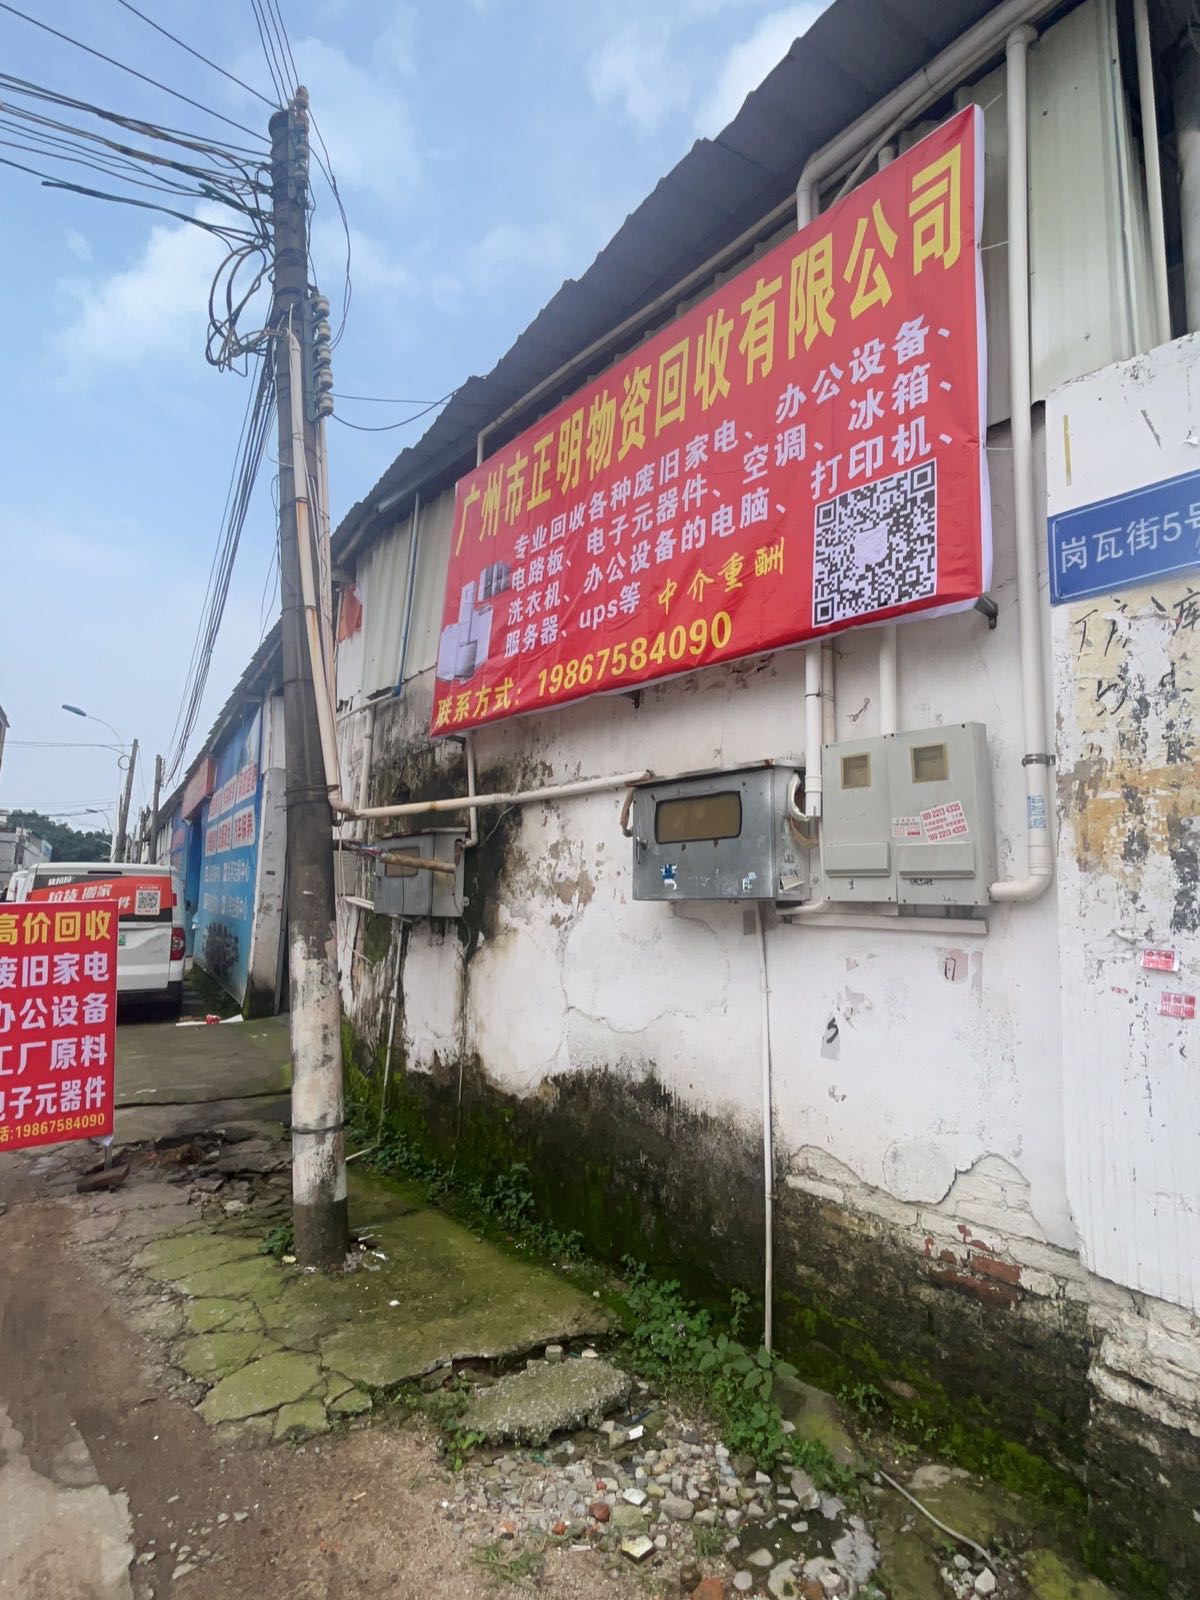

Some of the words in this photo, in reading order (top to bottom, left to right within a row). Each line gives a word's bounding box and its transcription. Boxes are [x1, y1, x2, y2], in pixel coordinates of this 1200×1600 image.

[455, 142, 961, 558] 广州市正明物资回收有限公司
[504, 580, 641, 659] 服务器、ups等
[538, 611, 732, 697] 19867584090
[0, 909, 112, 946] 高价回收
[0, 951, 110, 989] 废旧家电
